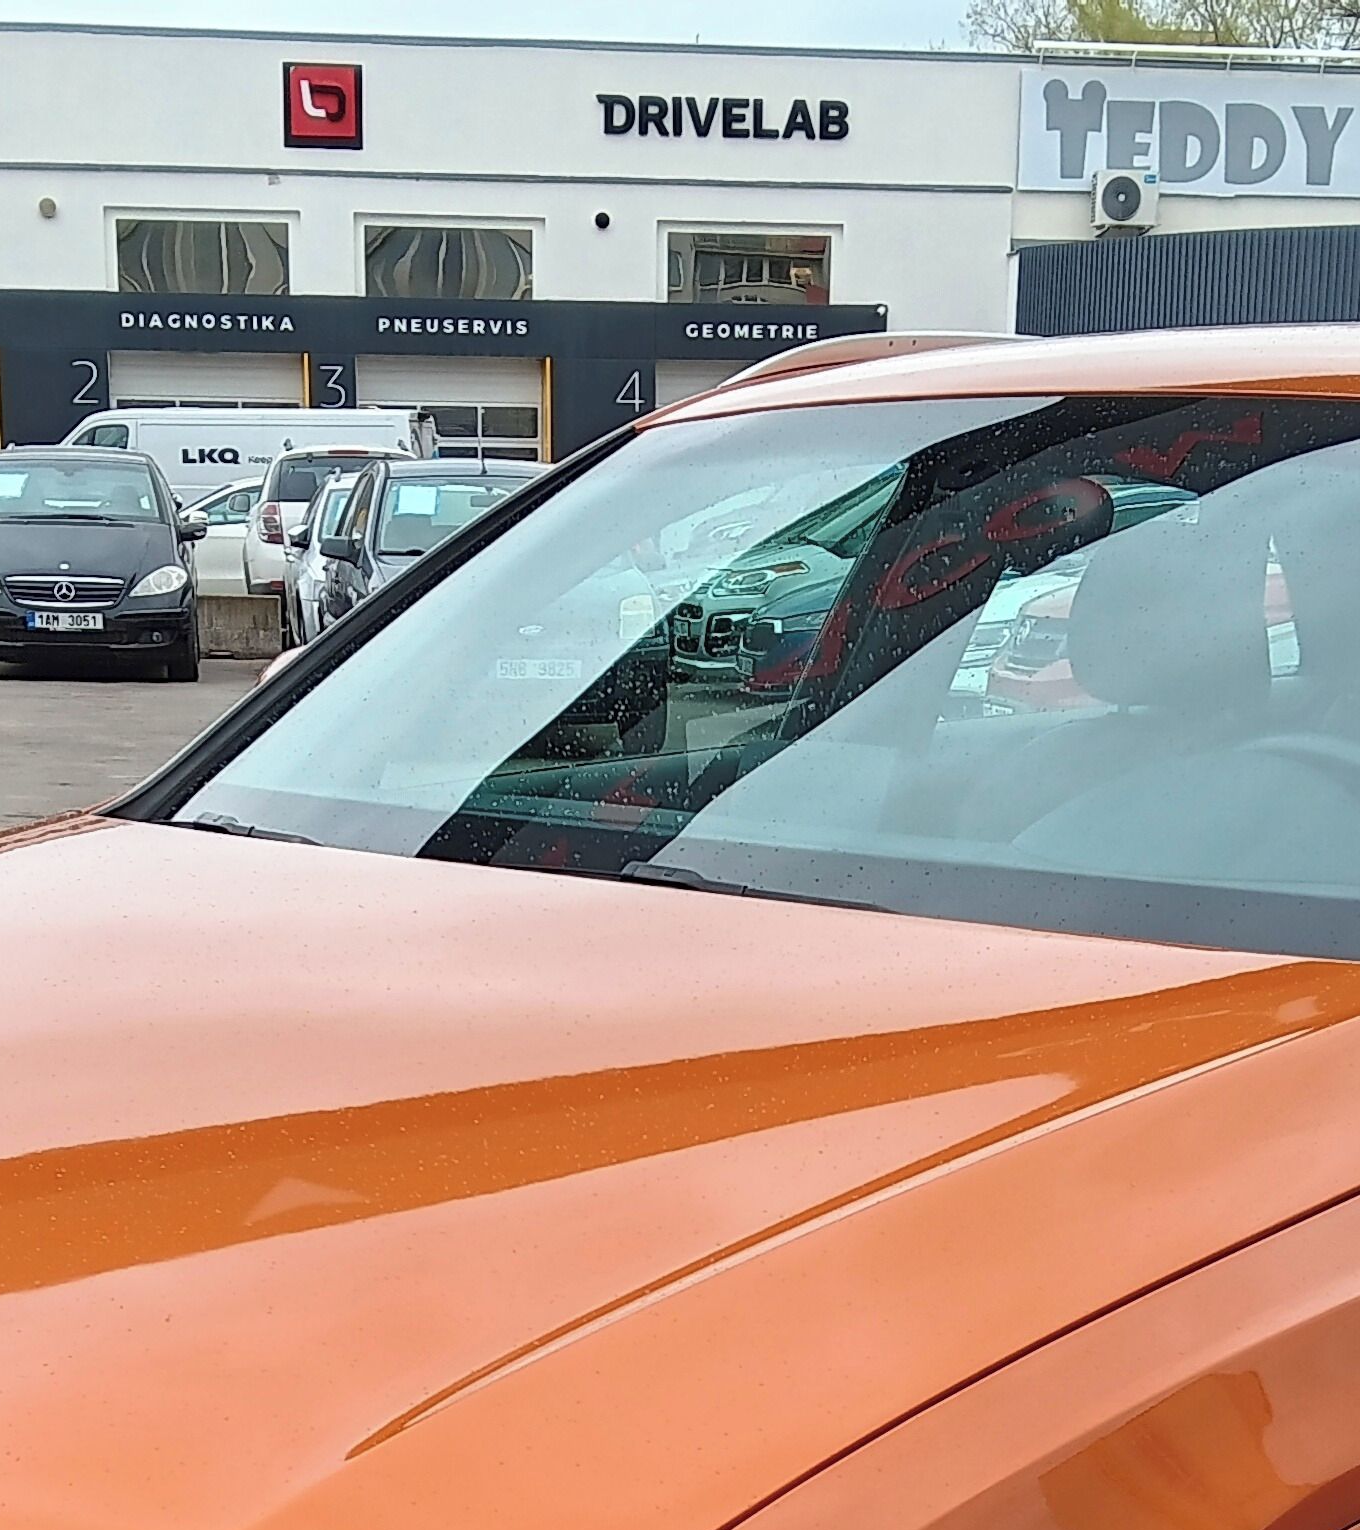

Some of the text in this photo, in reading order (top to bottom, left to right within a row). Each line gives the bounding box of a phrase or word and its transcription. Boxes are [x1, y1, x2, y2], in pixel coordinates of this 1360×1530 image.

[596, 93, 850, 140] DRIVELAB
[1043, 79, 1354, 185] TEDDY
[119, 312, 295, 332] DIAGNOSTIKA
[377, 317, 530, 336] PNEUSERVIS
[684, 322, 819, 340] GEOMETRIE
[71, 360, 99, 405] 2
[319, 365, 347, 409] 3
[615, 370, 646, 413] 4
[181, 447, 241, 465] LKQ
[38, 614, 97, 627] 1AM 3051
